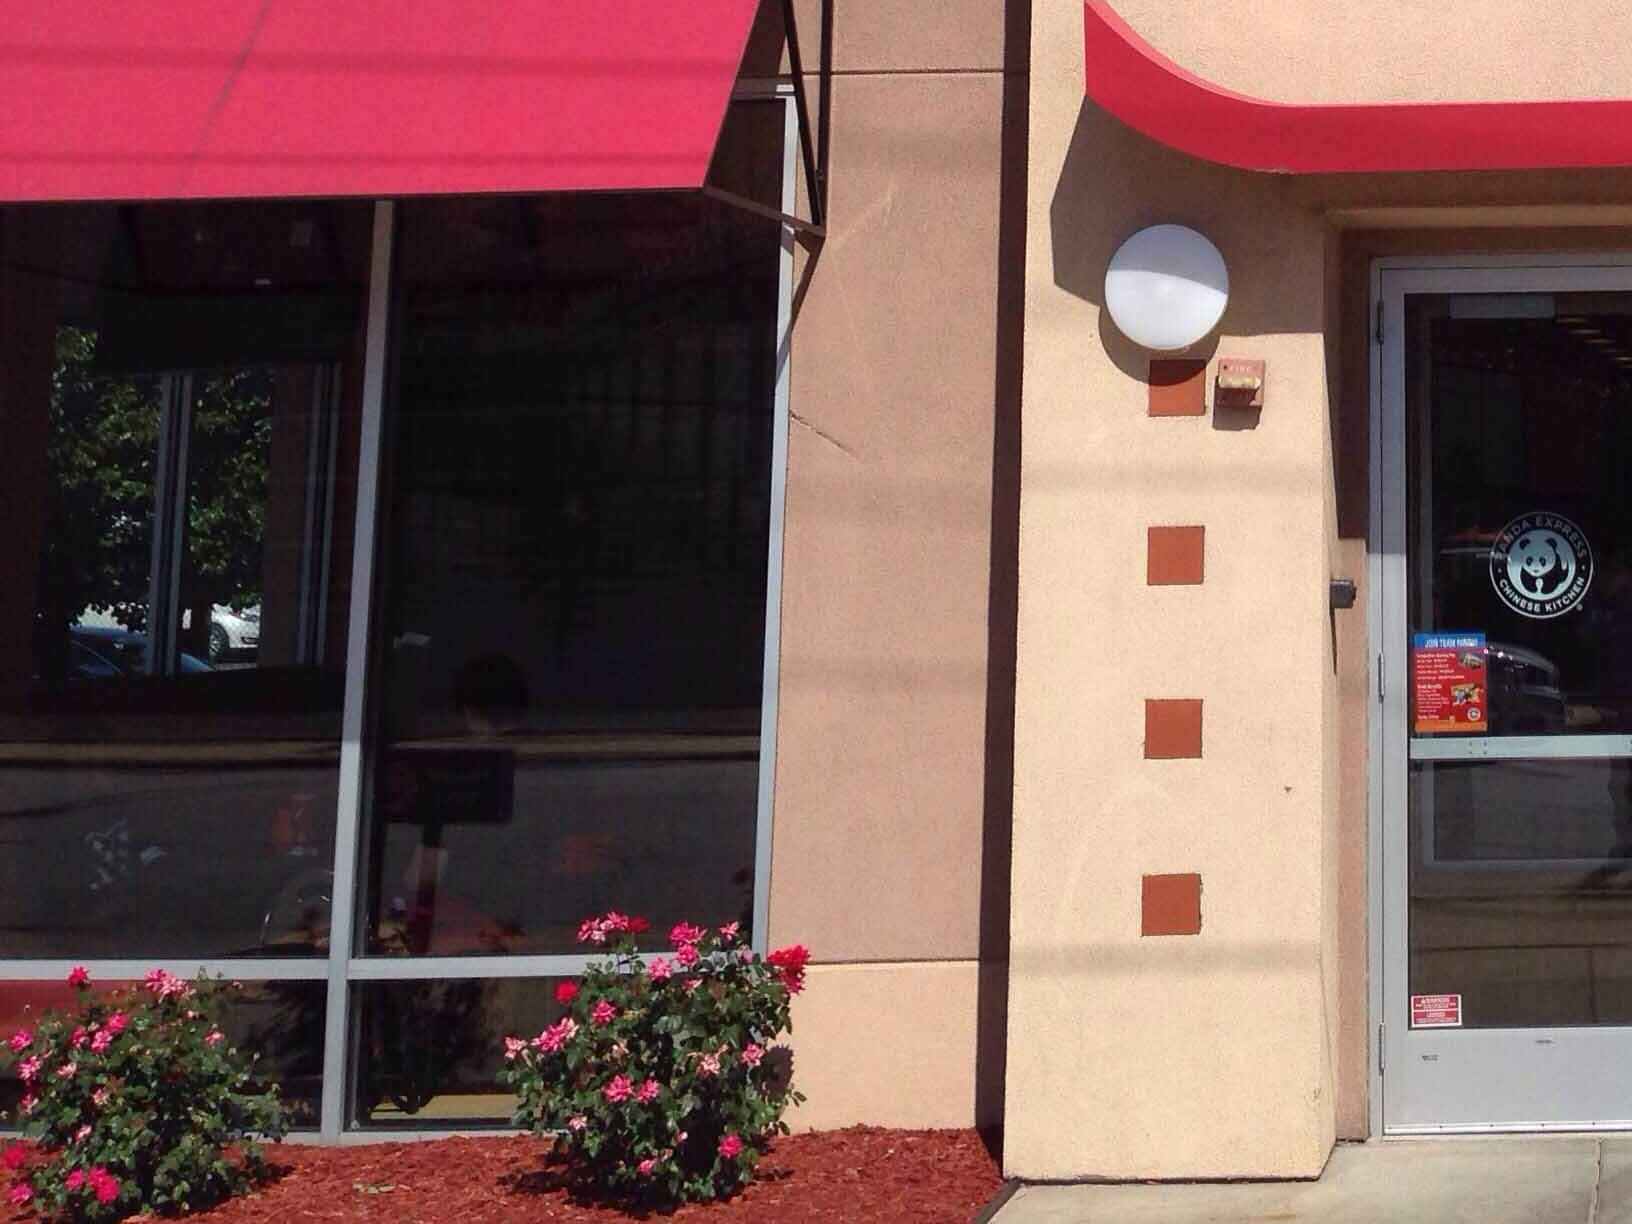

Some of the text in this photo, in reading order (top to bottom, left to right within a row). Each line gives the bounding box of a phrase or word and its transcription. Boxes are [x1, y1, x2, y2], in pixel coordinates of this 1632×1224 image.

[1535, 515, 1588, 558] EXPRESS
[1499, 576, 1585, 613] CHINESE KITCHEN
